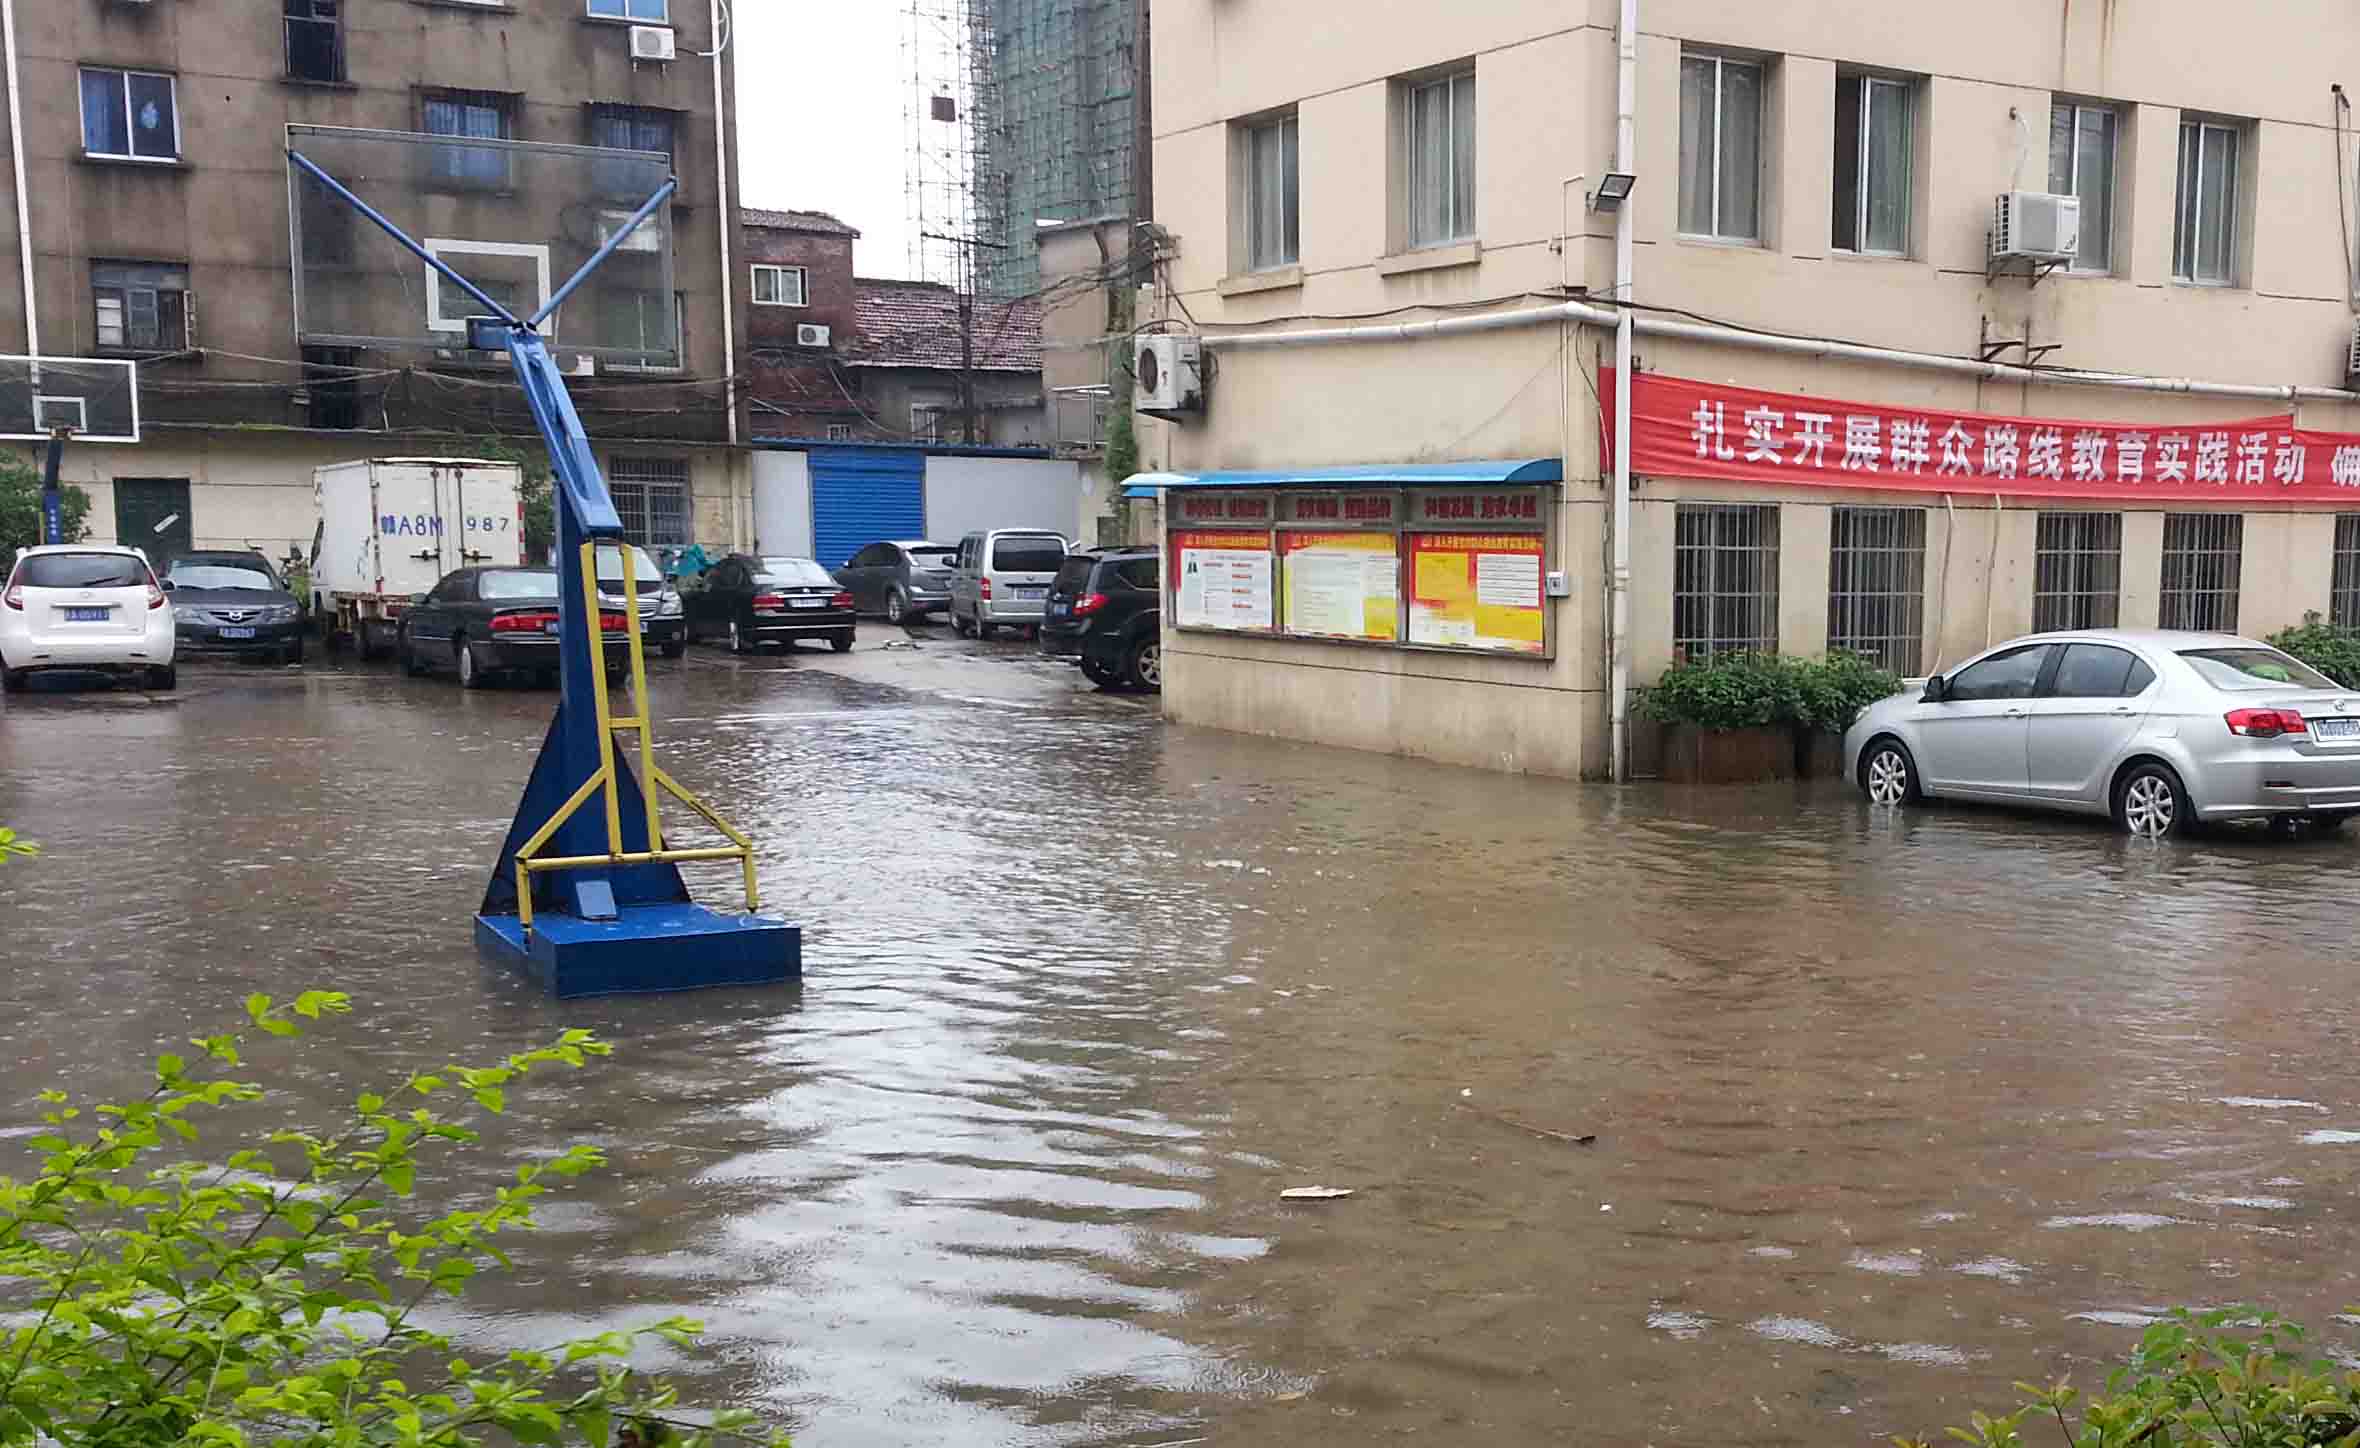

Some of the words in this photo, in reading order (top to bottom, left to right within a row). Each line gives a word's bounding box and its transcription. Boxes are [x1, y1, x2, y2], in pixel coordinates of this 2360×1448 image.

[1690, 399, 2305, 485] 扎实开展群众路线教育实践活动
[466, 516, 509, 532] 987
